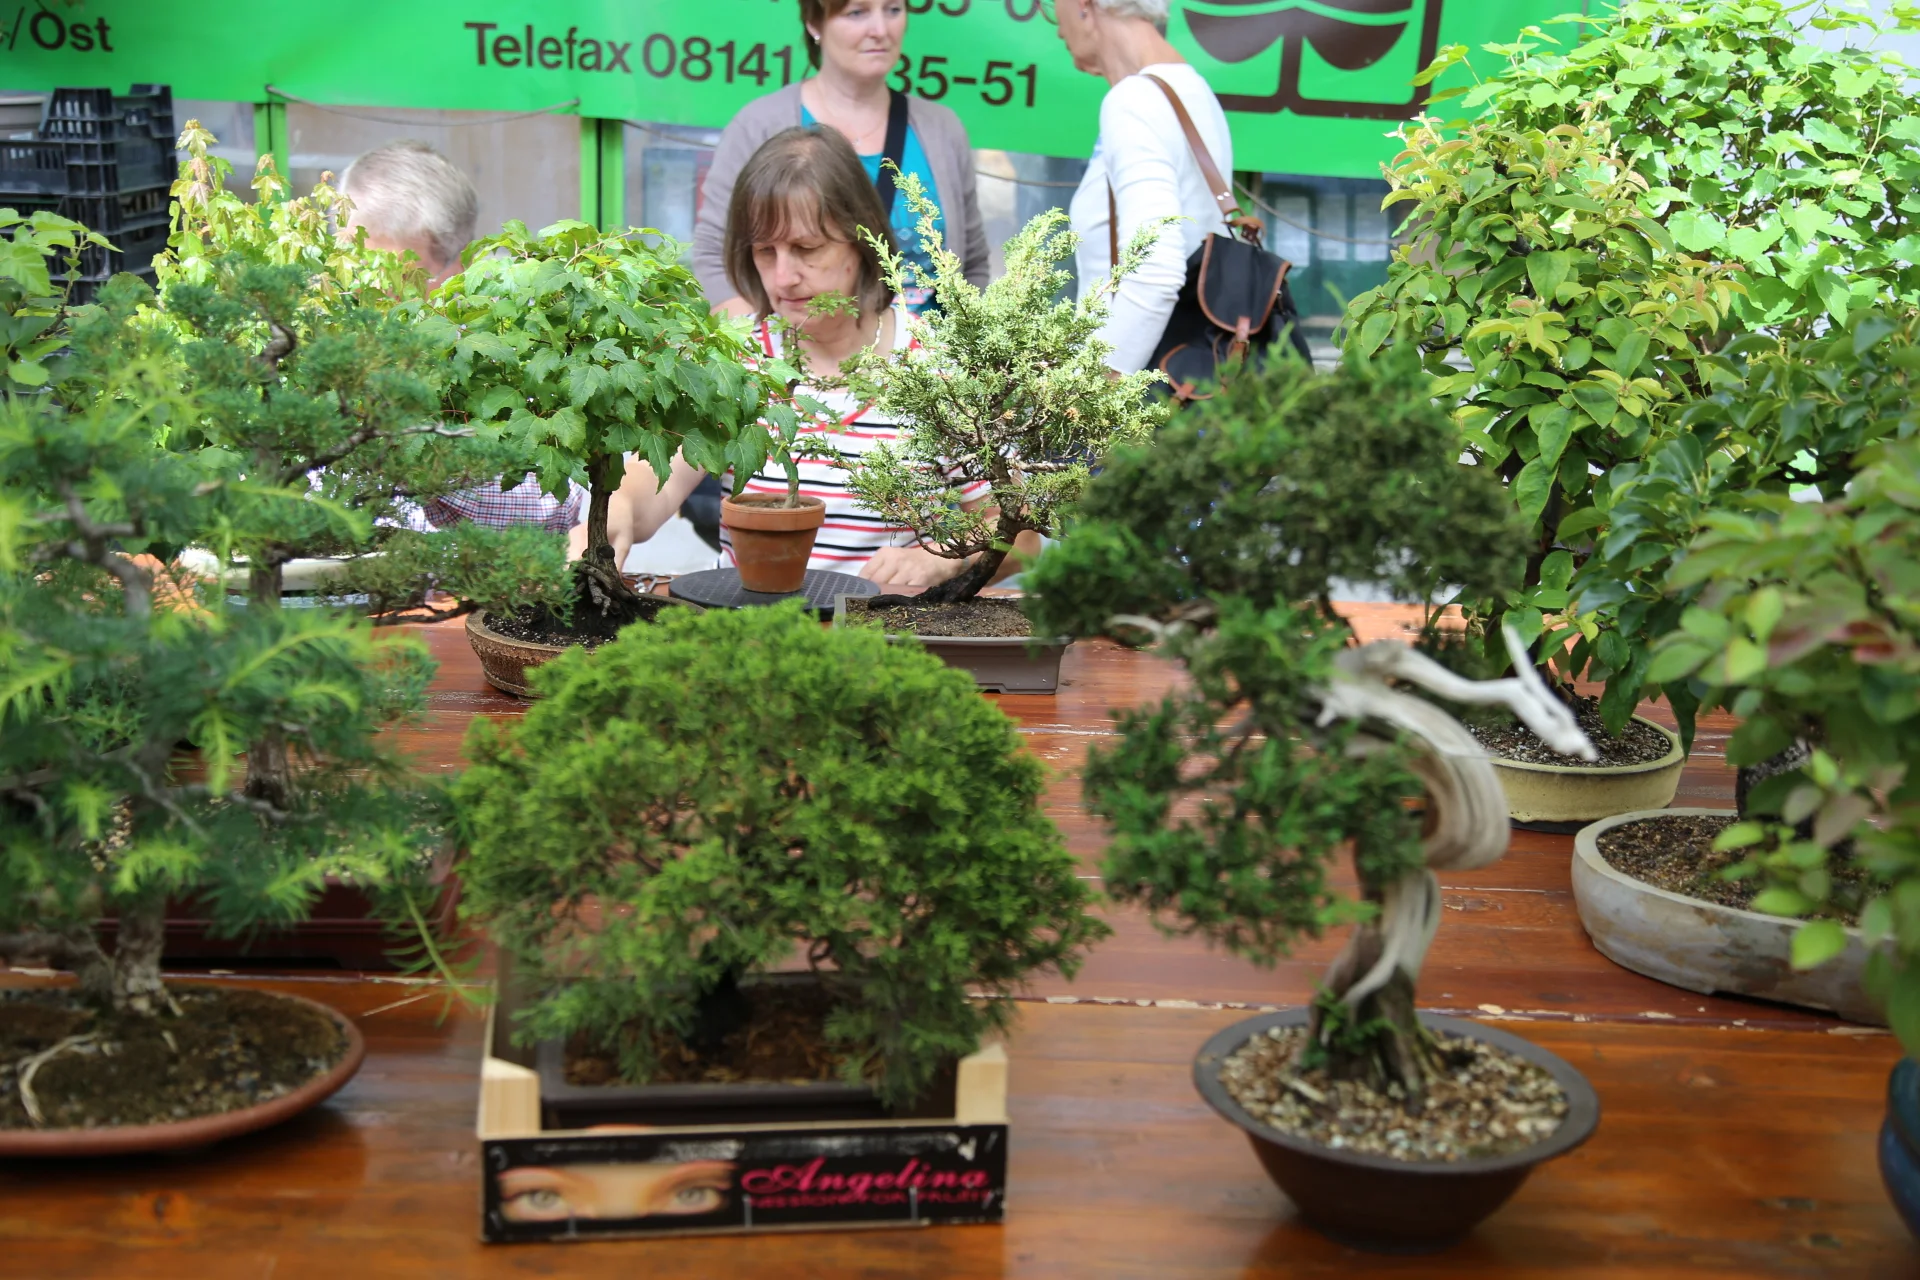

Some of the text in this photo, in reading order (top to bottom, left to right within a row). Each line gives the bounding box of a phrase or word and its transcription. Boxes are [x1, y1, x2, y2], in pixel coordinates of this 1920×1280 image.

[0, 6, 114, 52] /Ost
[464, 21, 632, 74] Telefax
[741, 1156, 990, 1197] Angelina
